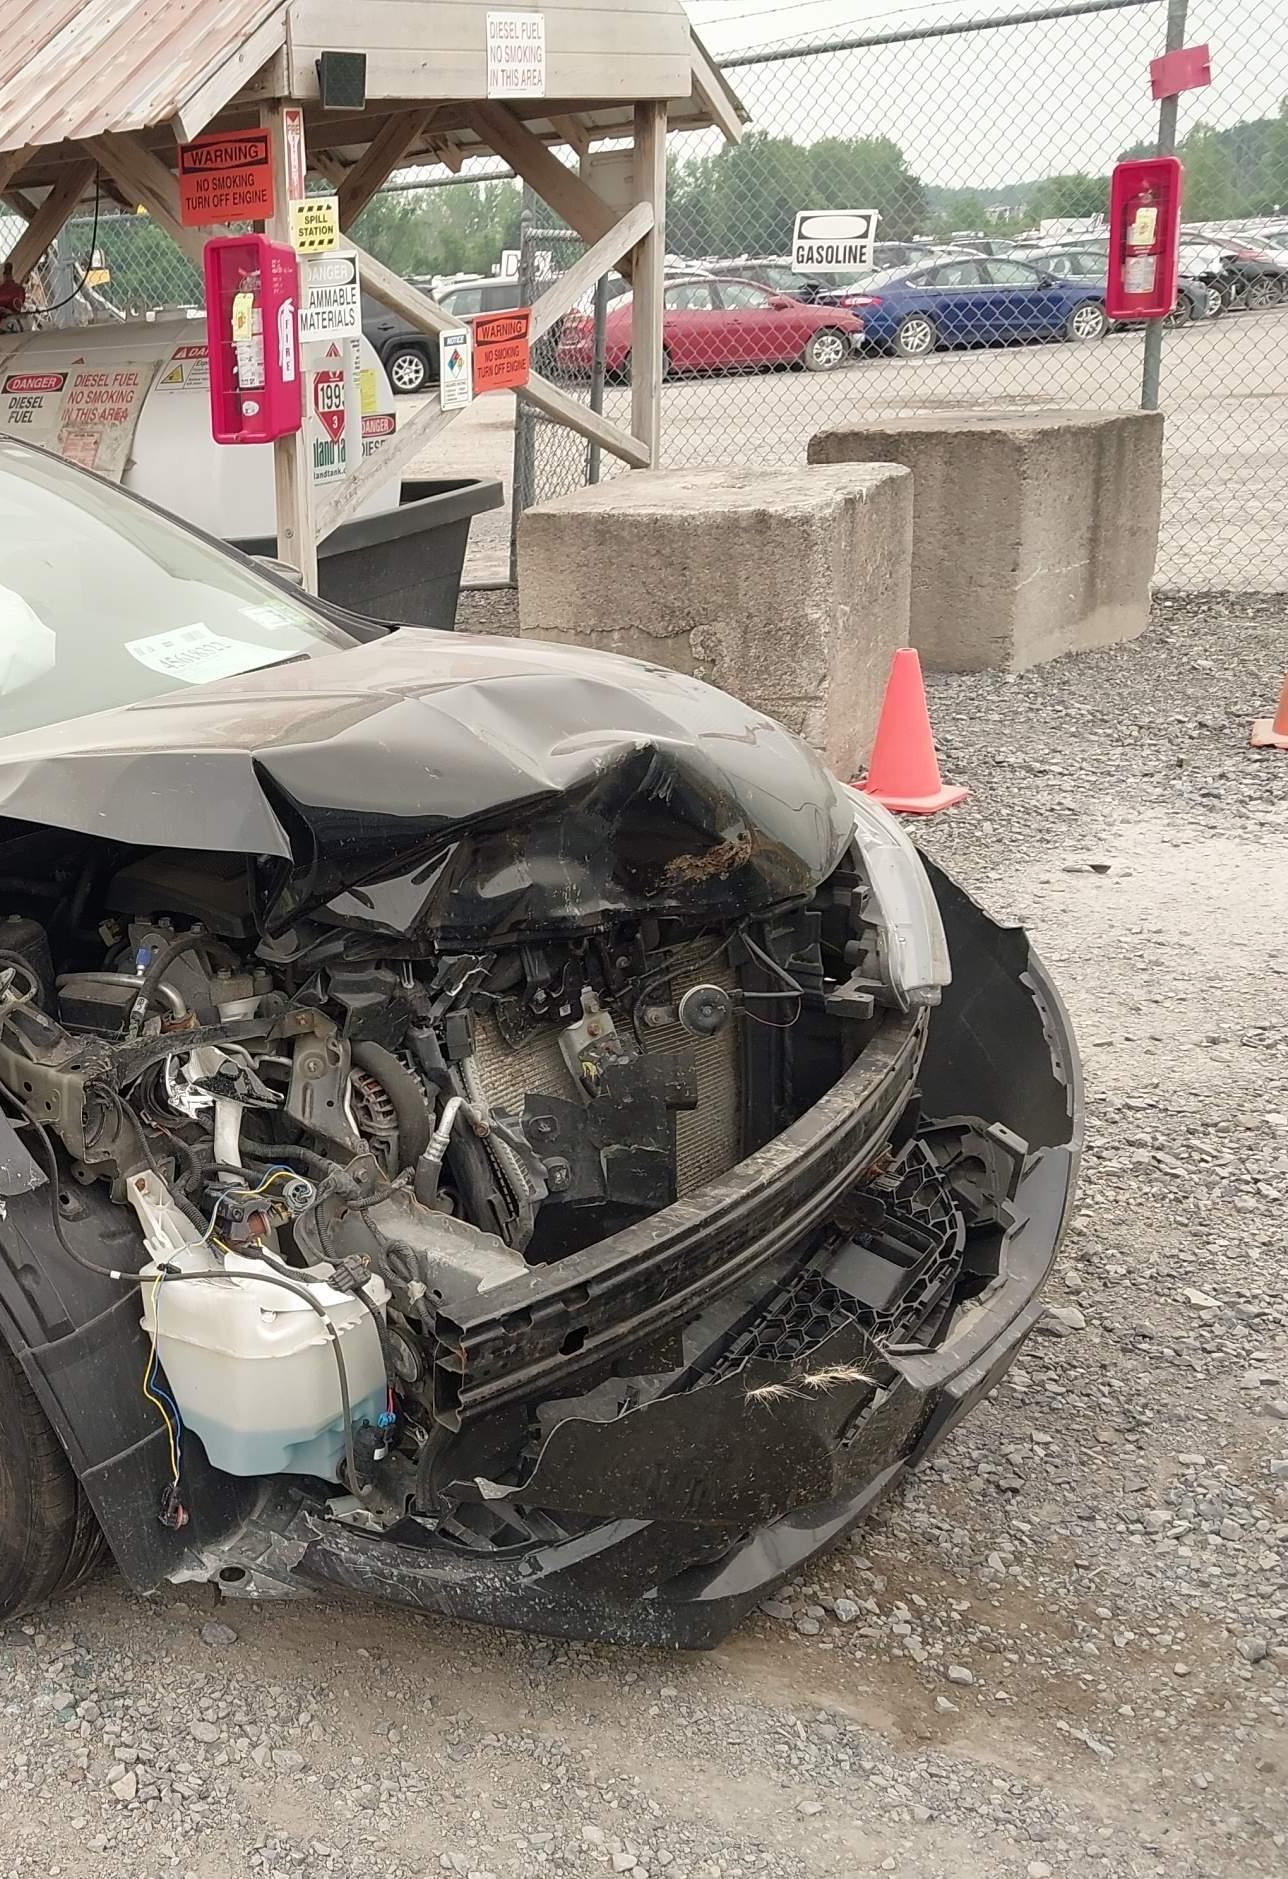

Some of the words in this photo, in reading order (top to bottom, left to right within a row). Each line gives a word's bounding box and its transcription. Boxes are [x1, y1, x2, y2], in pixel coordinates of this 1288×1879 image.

[489, 21, 519, 40] DIESEL
[521, 22, 542, 40] FUEL
[490, 45, 503, 63] NO
[504, 45, 543, 64] SMOKING
[489, 69, 499, 87] IN
[500, 68, 519, 87] THIS
[520, 69, 543, 87] AREA
[190, 144, 259, 166] WARNING
[196, 178, 210, 193] NO
[212, 173, 255, 190] SMOKING
[186, 196, 211, 211] TURN
[212, 193, 230, 208] OFF
[232, 189, 267, 206] ENGINE
[304, 215, 328, 225] SPILL
[298, 225, 334, 237] STATION
[796, 244, 867, 265] GASOLINE
[309, 286, 357, 309] AMMABLE
[300, 308, 356, 332] MATERIALS
[482, 320, 522, 340] WARNING
[484, 350, 493, 363] NO
[494, 345, 520, 361] SMOKING
[477, 365, 493, 379] TURN
[494, 362, 505, 376] OFF
[506, 358, 527, 373] ENGINE
[11, 377, 57, 390] DANGER
[74, 374, 110, 388] DIESEL
[112, 372, 140, 387] FUEL
[8, 396, 44, 410] DIESEL
[67, 391, 85, 404] NO
[85, 390, 134, 404] SMOKING
[7, 410, 33, 424] FUEL
[61, 408, 72, 422] IN
[75, 408, 97, 422] THIS
[98, 407, 129, 422] AREA
[332, 415, 339, 429] 3
[362, 418, 389, 433] DANGER
